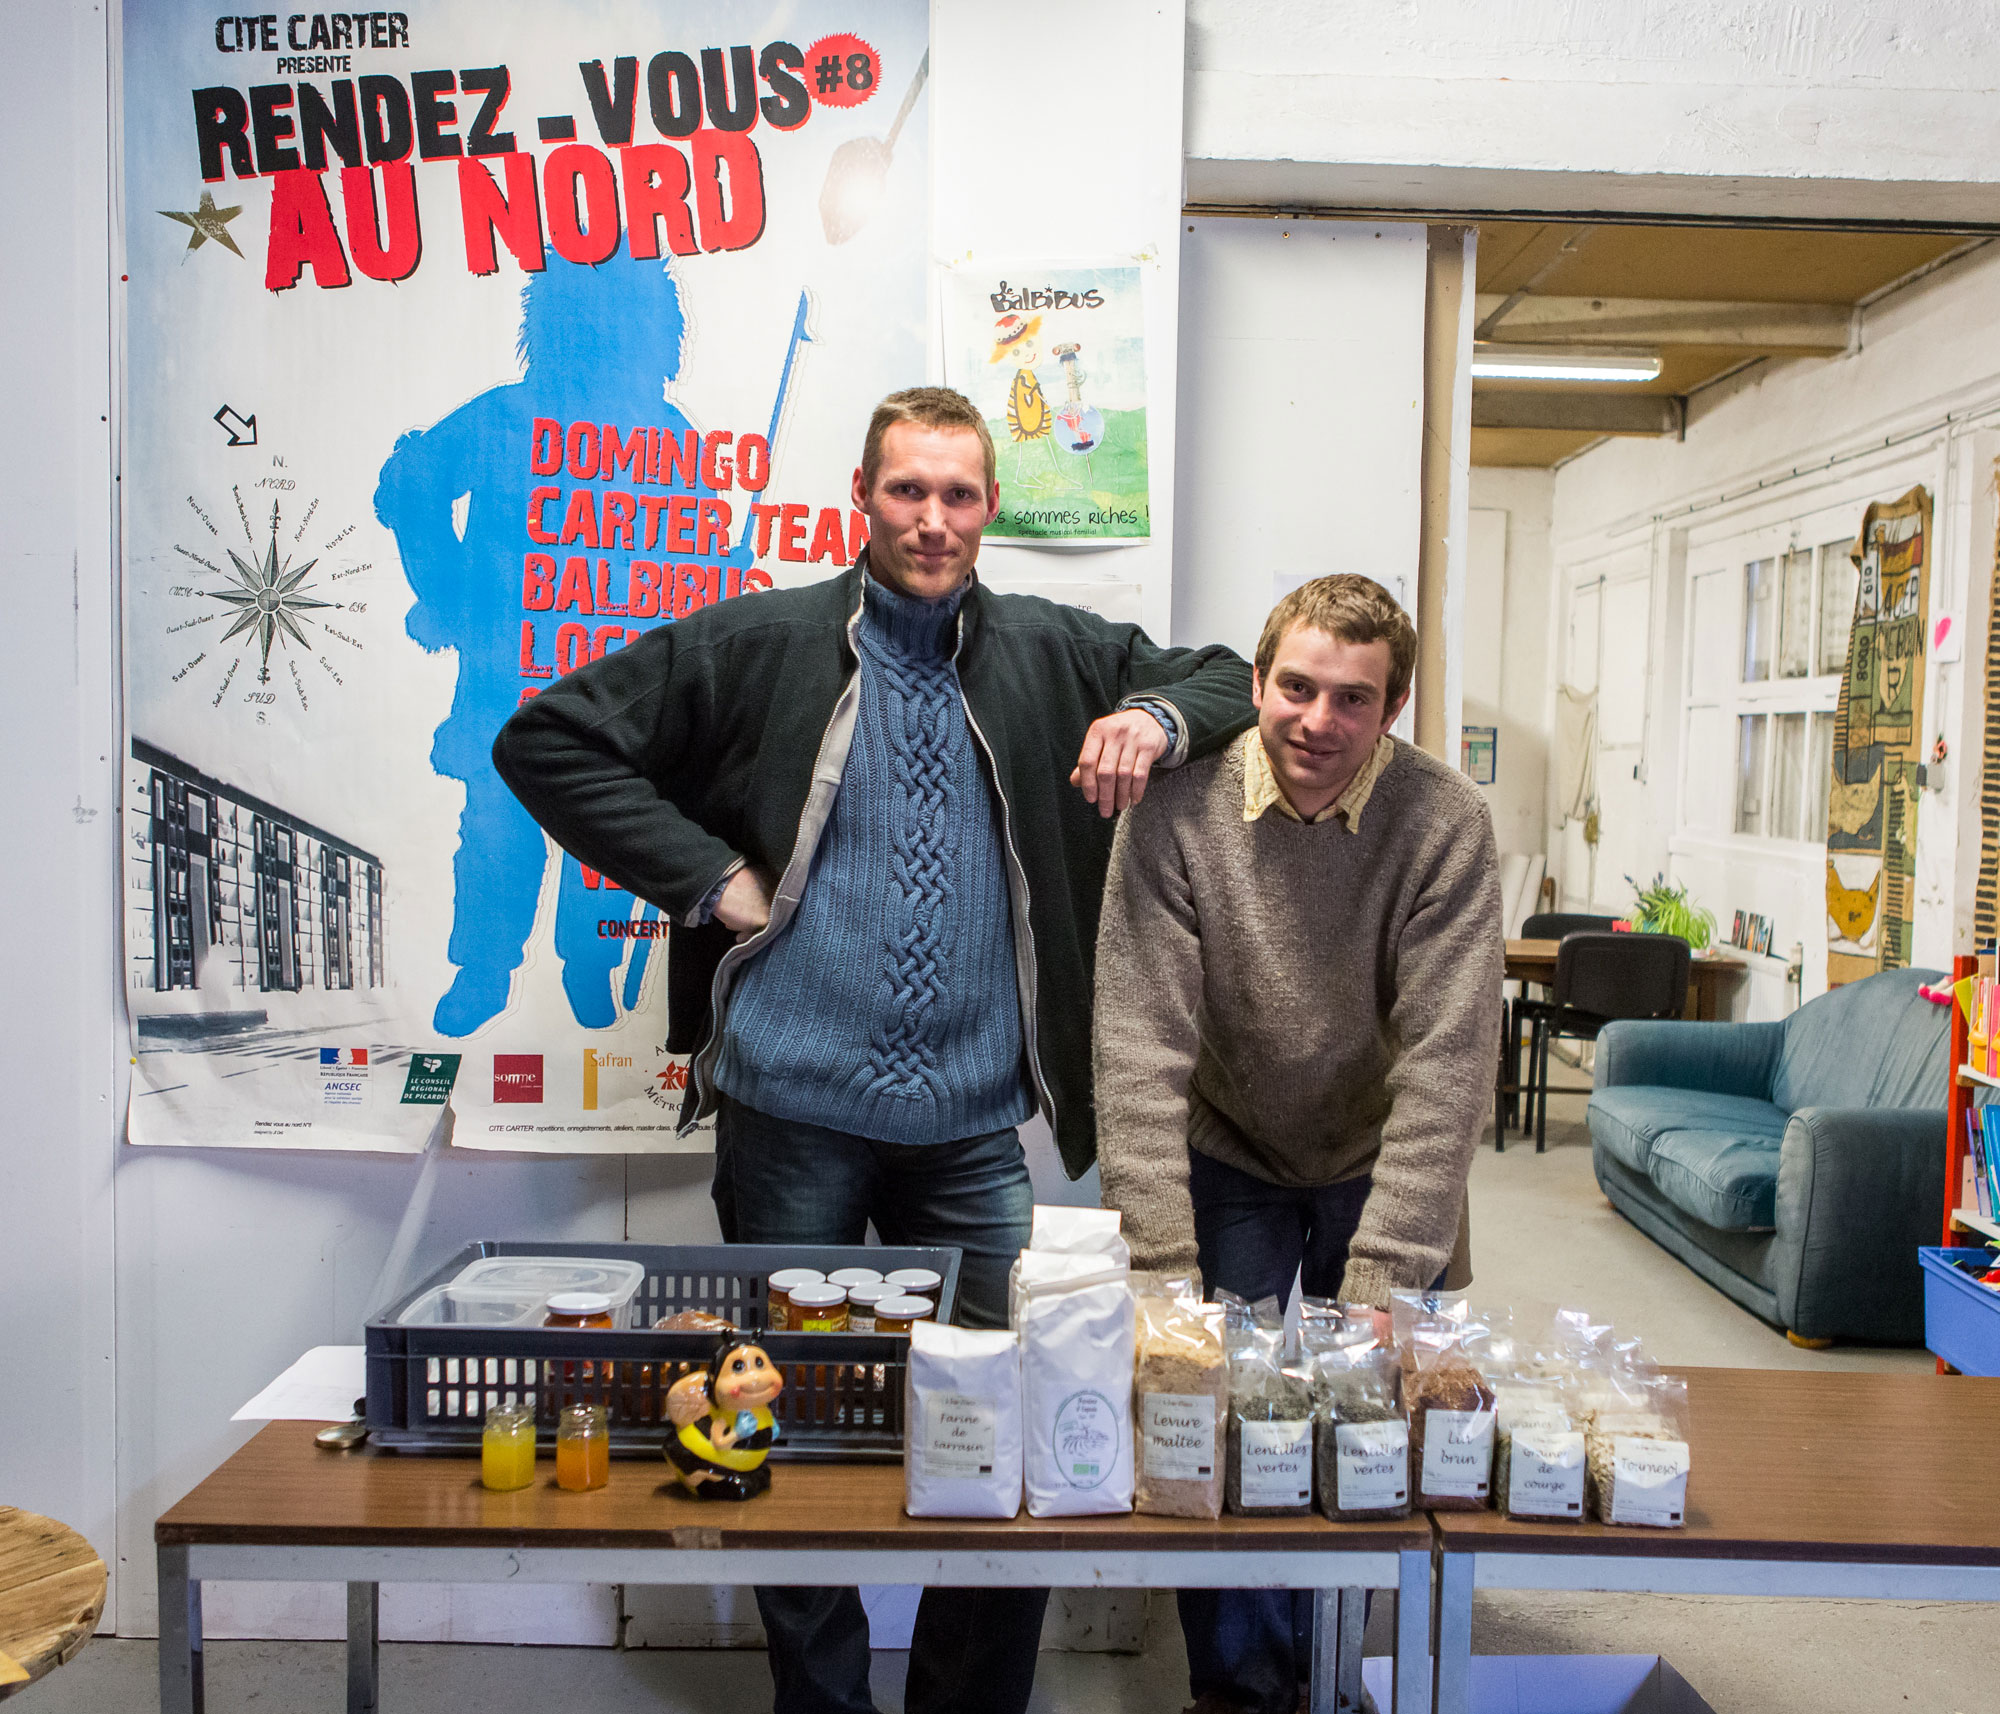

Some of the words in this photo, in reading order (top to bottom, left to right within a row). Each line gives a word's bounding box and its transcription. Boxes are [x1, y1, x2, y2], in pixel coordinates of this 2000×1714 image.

[214, 14, 278, 53] CITE
[287, 11, 410, 52] CARTER
[276, 56, 351, 74] PRESENTE
[814, 53, 873, 96] #8
[192, 64, 517, 183] RENDEZ
[264, 162, 424, 294] AU
[456, 128, 766, 277] NORD
[530, 417, 771, 492] DOMINGO
[526, 487, 733, 556] CARTER
[171, 652, 207, 683] Sud-Ouest
[597, 919, 670, 940] CONCERT
[590, 1052, 632, 1067] Safran
[324, 1082, 362, 1091] ANCSEC
[494, 1073, 537, 1084] somme
[1153, 1412, 1204, 1429] Levure
[1440, 1449, 1478, 1465] brun
[1256, 1463, 1299, 1475] vertes
[1353, 1464, 1397, 1476] vertes
[1524, 1480, 1566, 1494] courge
